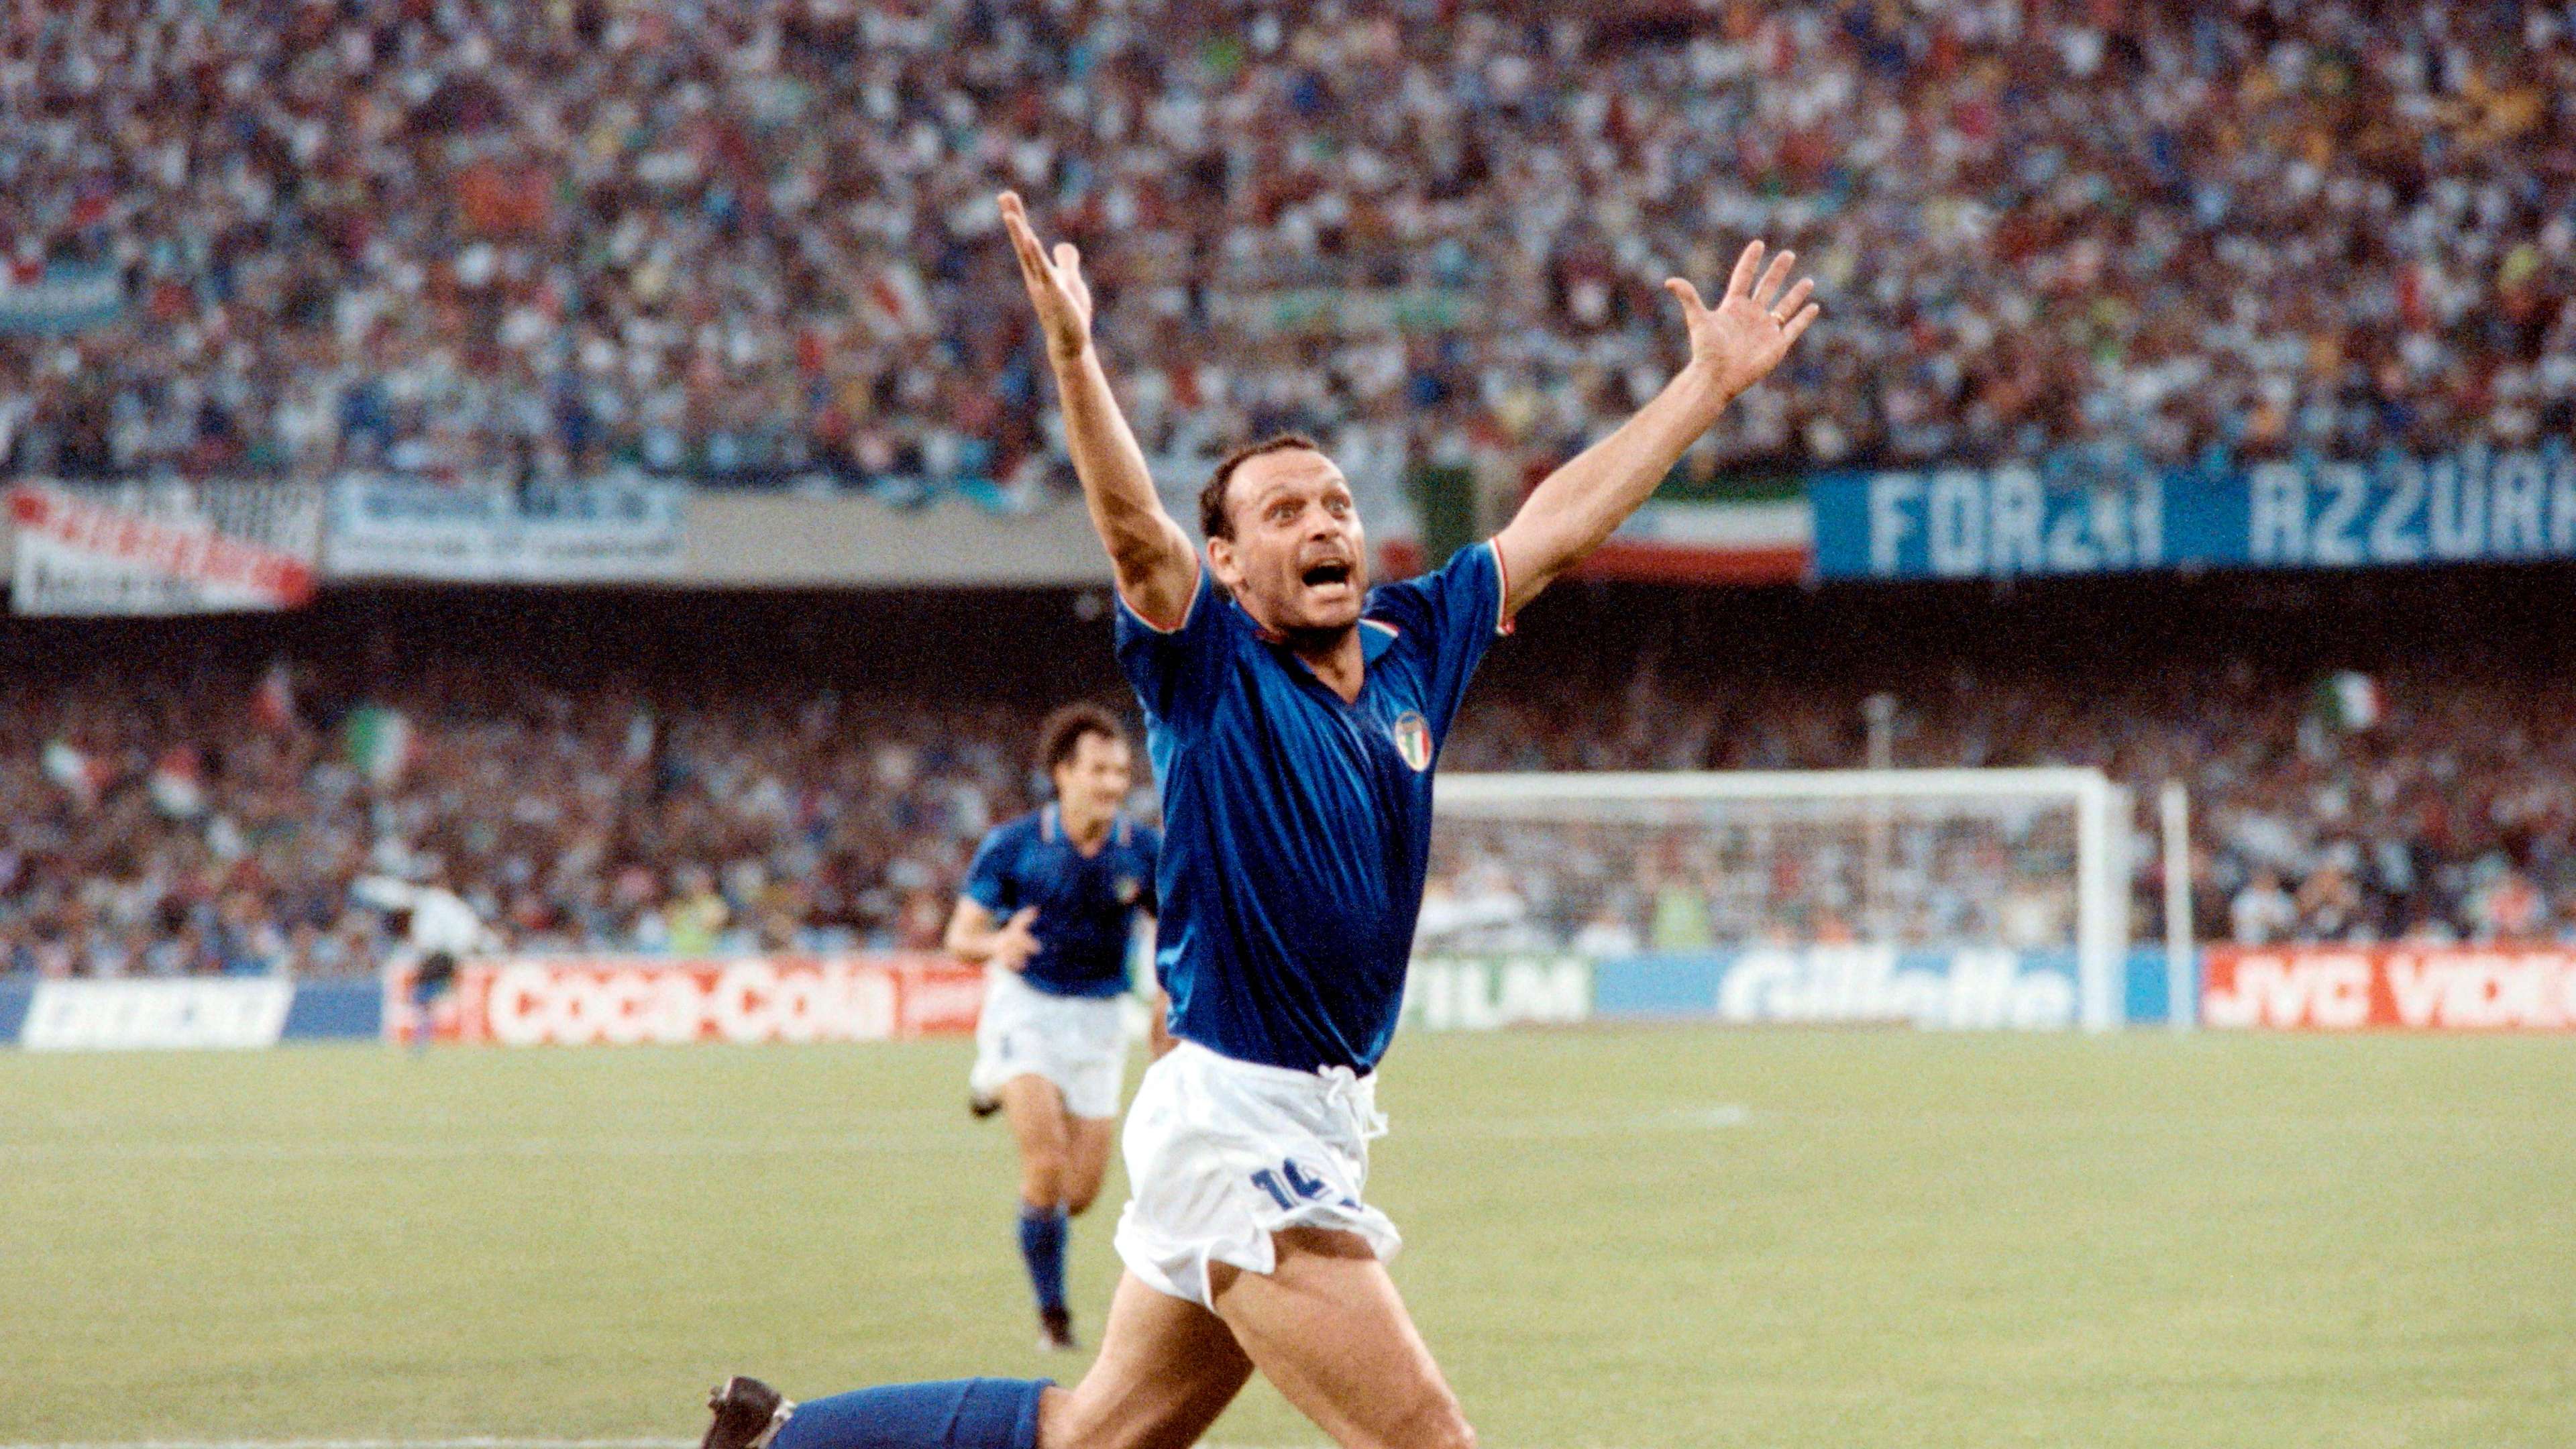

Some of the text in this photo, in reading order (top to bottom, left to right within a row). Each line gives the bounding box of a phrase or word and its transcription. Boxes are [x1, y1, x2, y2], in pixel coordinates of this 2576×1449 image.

[488, 959, 895, 1044] Coca-Cola
[1720, 947, 2076, 1029] Gillette
[2204, 954, 2576, 1028] JVC VIDE
